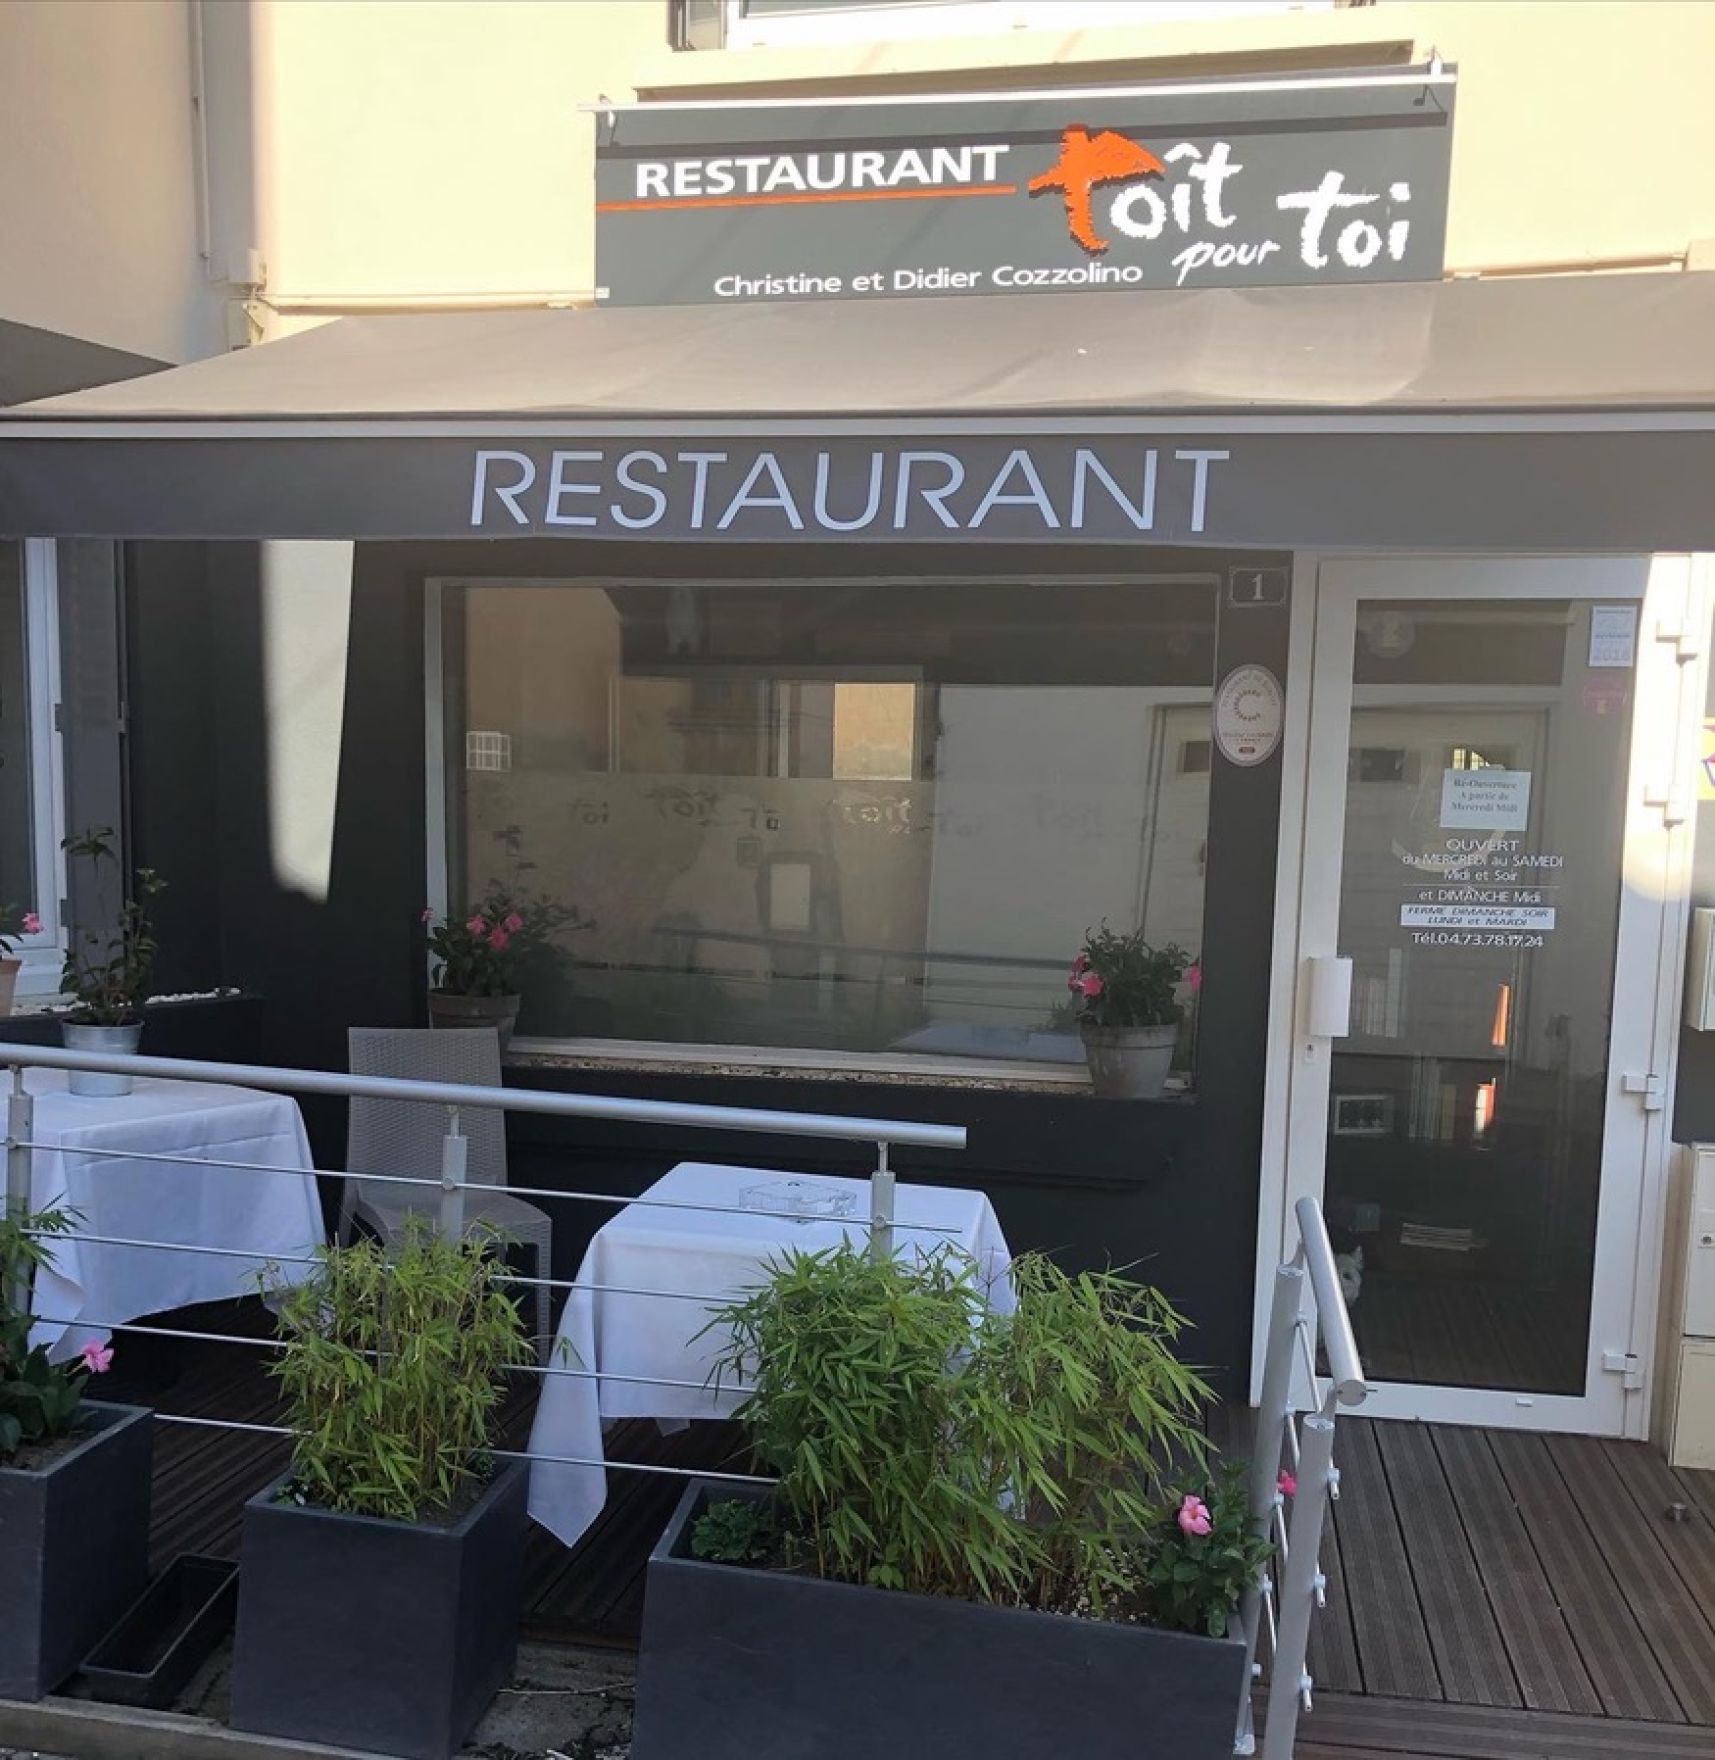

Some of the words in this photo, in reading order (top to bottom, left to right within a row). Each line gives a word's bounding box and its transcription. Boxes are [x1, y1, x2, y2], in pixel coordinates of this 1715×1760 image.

[637, 144, 1010, 197] RESTAURANT
[1029, 123, 1243, 257] toît
[1277, 170, 1411, 269] toi
[1170, 241, 1280, 286] pour
[714, 273, 842, 297] Christine
[851, 273, 884, 291] et
[894, 268, 982, 291] Didier
[992, 262, 1143, 287] Cozzolino
[471, 449, 1230, 533] RESTAURANT
[1252, 573, 1264, 600] 1
[1446, 838, 1519, 851] OUVERT
[1403, 853, 1418, 865] du
[1423, 853, 1487, 867] MERCREDI
[1491, 856, 1507, 866] au
[1513, 854, 1563, 868] SAMEDI
[1444, 868, 1470, 881] Midi
[1475, 869, 1488, 881] et
[1495, 869, 1518, 881] Soir
[1419, 890, 1432, 901] et
[1438, 890, 1509, 902] DIMANCHE
[1513, 891, 1541, 903] Midi
[1428, 916, 1462, 925] LUNDI
[1467, 917, 1480, 925] et
[1486, 917, 1528, 926] MARDI
[1452, 907, 1515, 917] DIMANCHE
